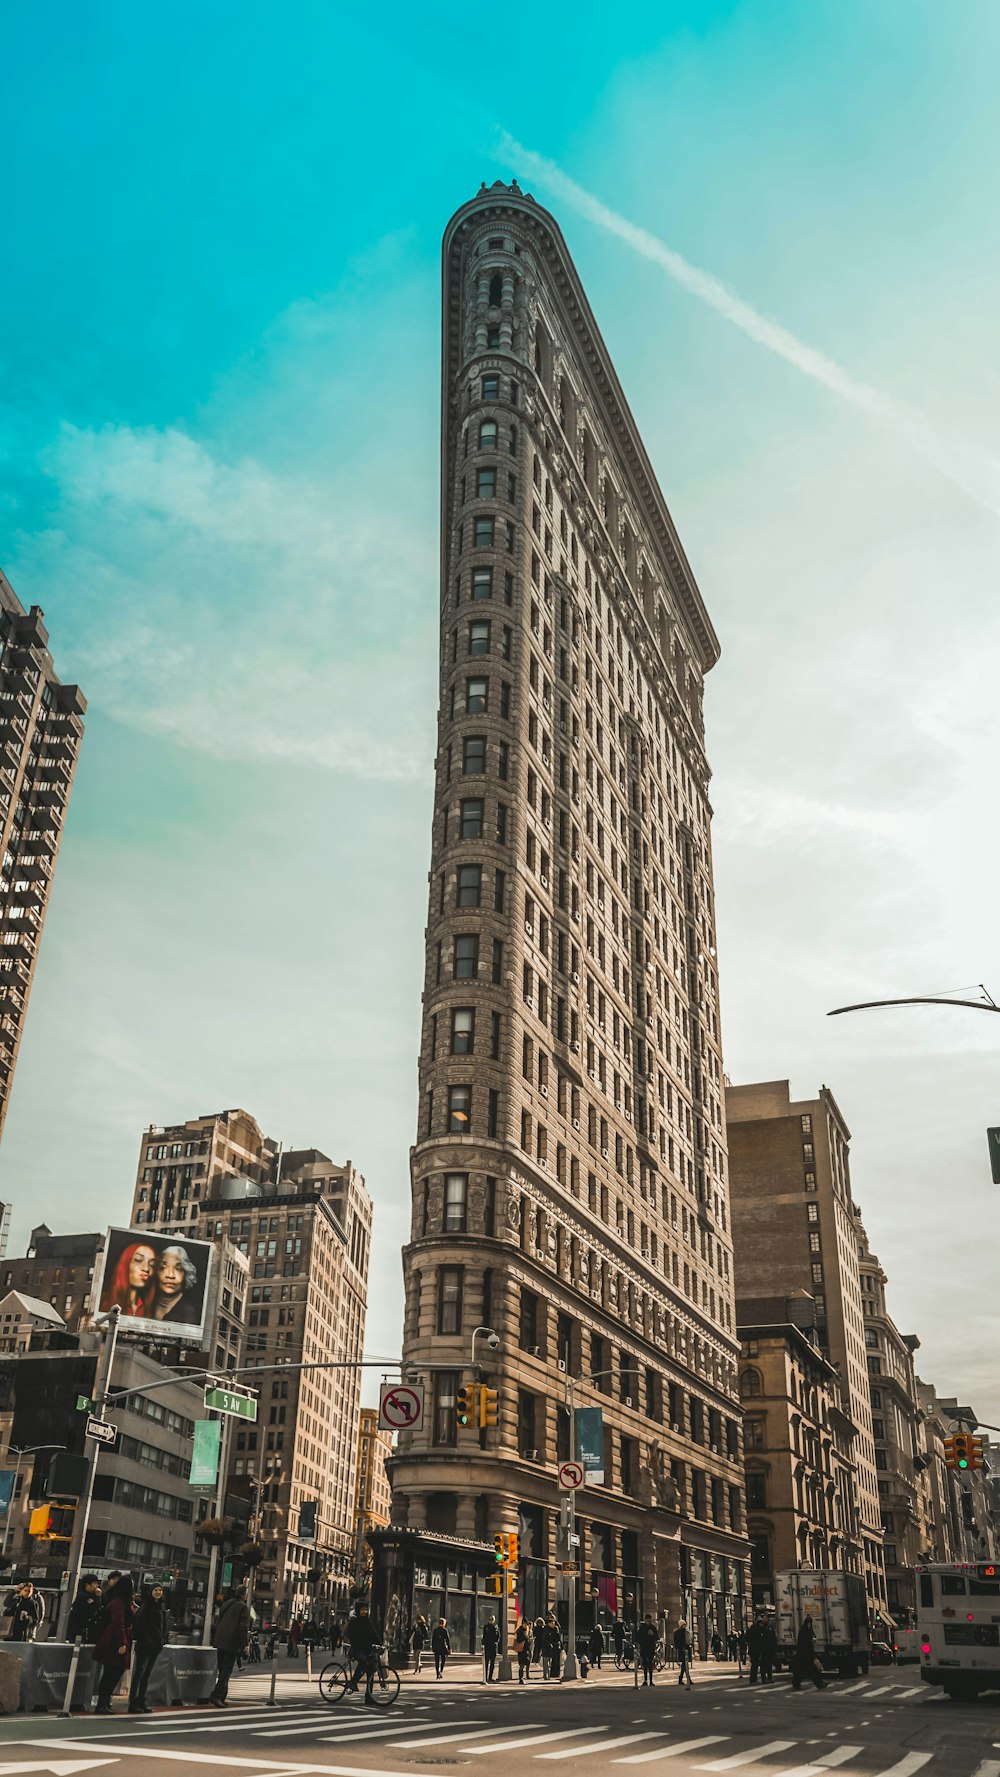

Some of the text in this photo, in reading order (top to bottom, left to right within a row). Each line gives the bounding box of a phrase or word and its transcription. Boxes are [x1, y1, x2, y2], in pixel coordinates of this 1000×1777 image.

[82, 1399, 88, 1409] 5
[223, 1395, 240, 1411] 5 Av
[91, 1424, 112, 1437] ONE WAY
[787, 1584, 839, 1596] freshdirect
